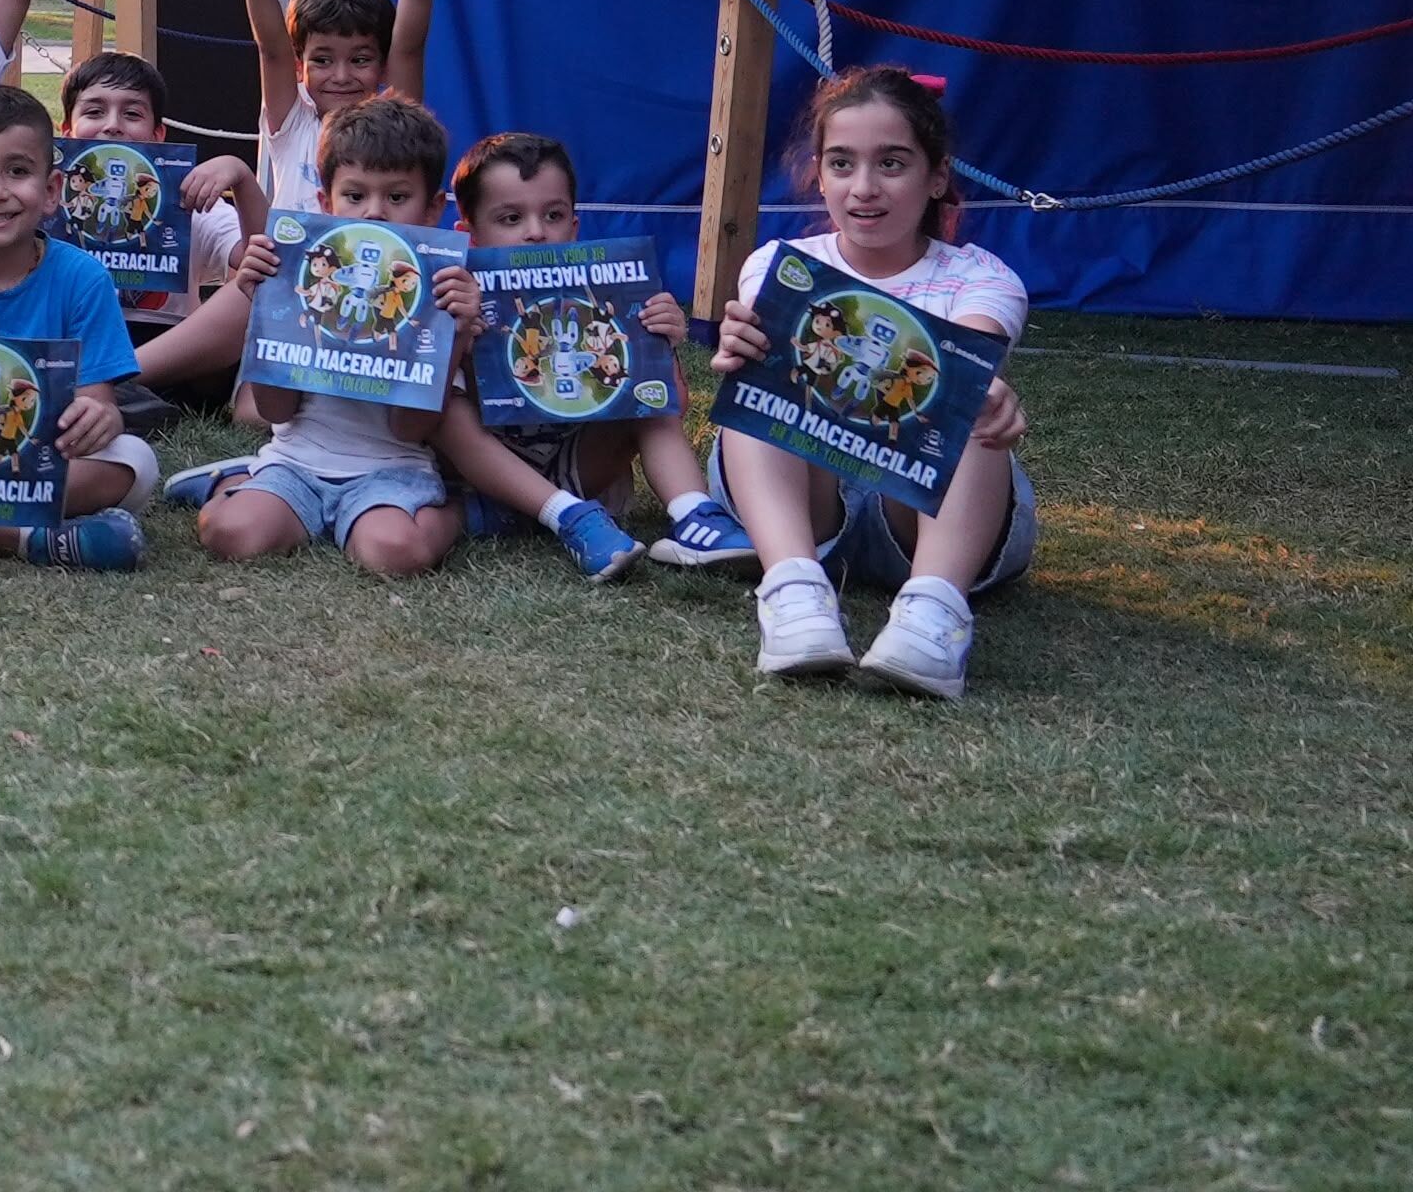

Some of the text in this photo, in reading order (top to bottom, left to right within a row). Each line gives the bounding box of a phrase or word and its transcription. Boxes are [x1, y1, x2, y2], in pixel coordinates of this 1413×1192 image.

[473, 260, 649, 292] TEKNO MACERACILAR
[256, 338, 435, 385] TEKNO MACERACILAR
[733, 381, 938, 490] TEKNO MACERACILAR
